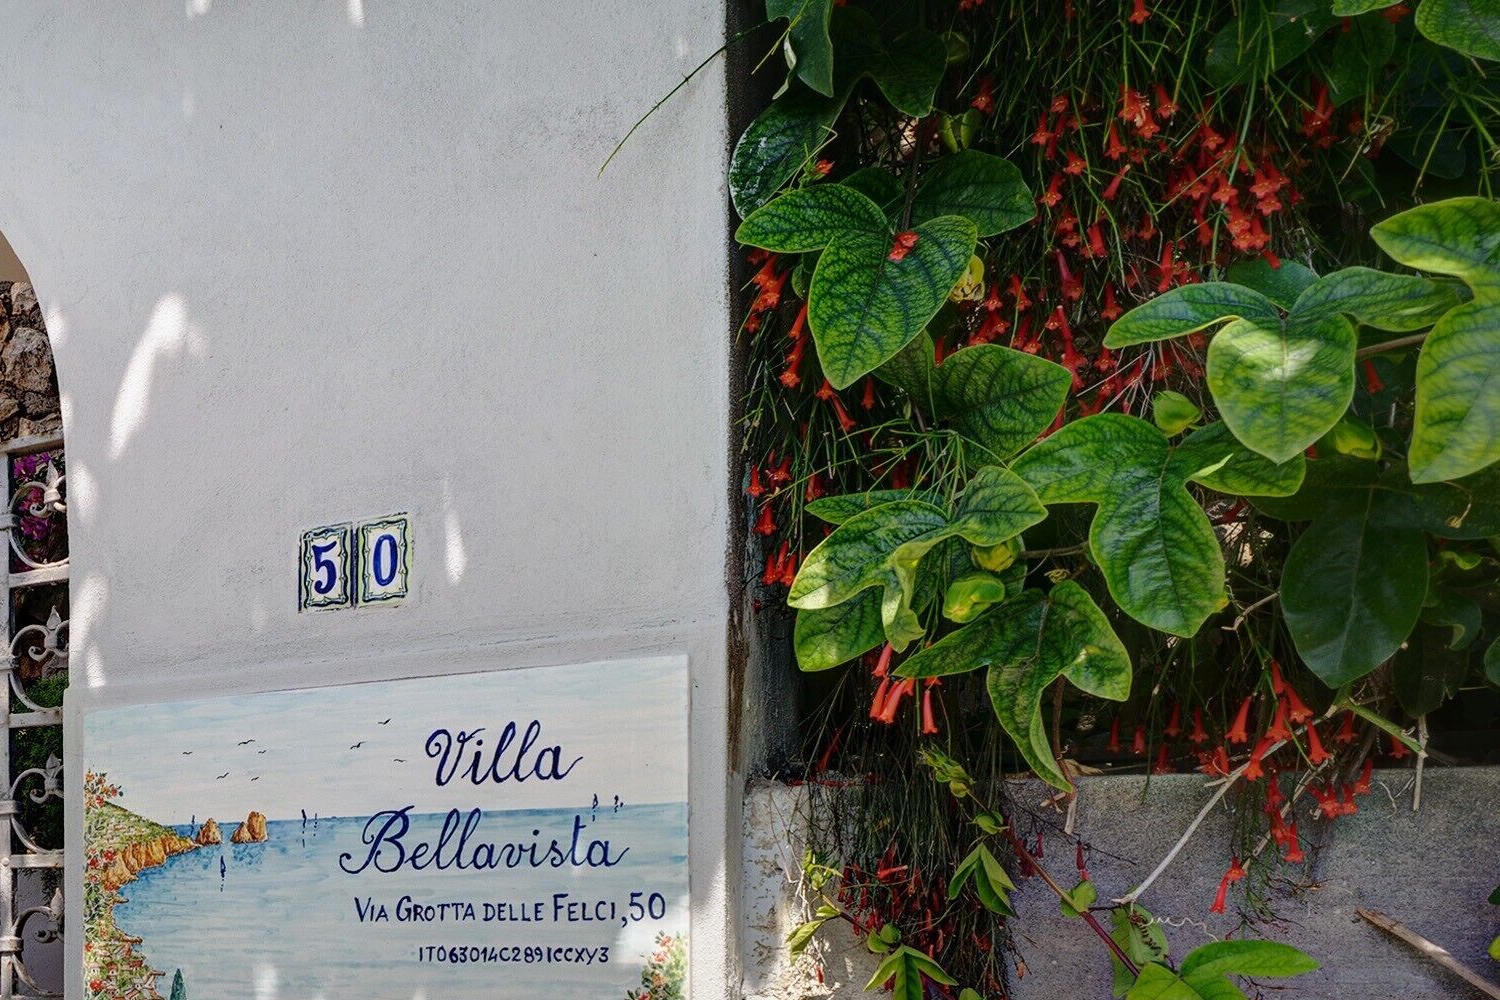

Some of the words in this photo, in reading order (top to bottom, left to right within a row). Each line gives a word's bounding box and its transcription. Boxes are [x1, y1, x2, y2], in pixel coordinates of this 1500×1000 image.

[311, 533, 399, 595] 50
[424, 719, 584, 787] Villa
[338, 804, 630, 876] Bellavista
